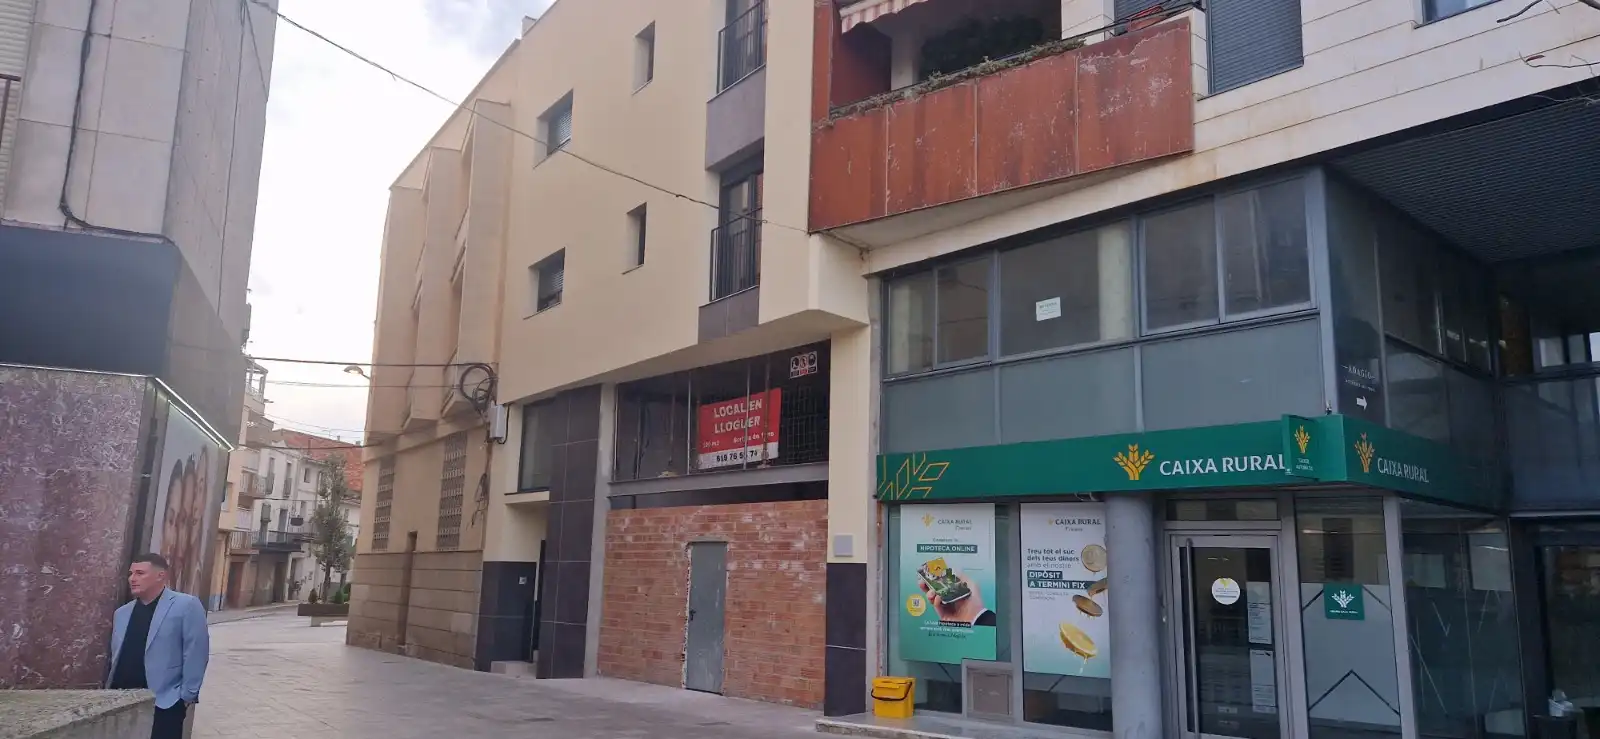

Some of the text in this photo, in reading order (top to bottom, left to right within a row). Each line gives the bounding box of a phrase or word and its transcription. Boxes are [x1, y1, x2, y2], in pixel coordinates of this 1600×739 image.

[713, 399, 763, 418] LOCAL EN
[1159, 453, 1286, 476] CAIXA RURAL
[1377, 457, 1430, 483] CAIXA RURAL
[1029, 580, 1086, 589] A TERMINI FIX
